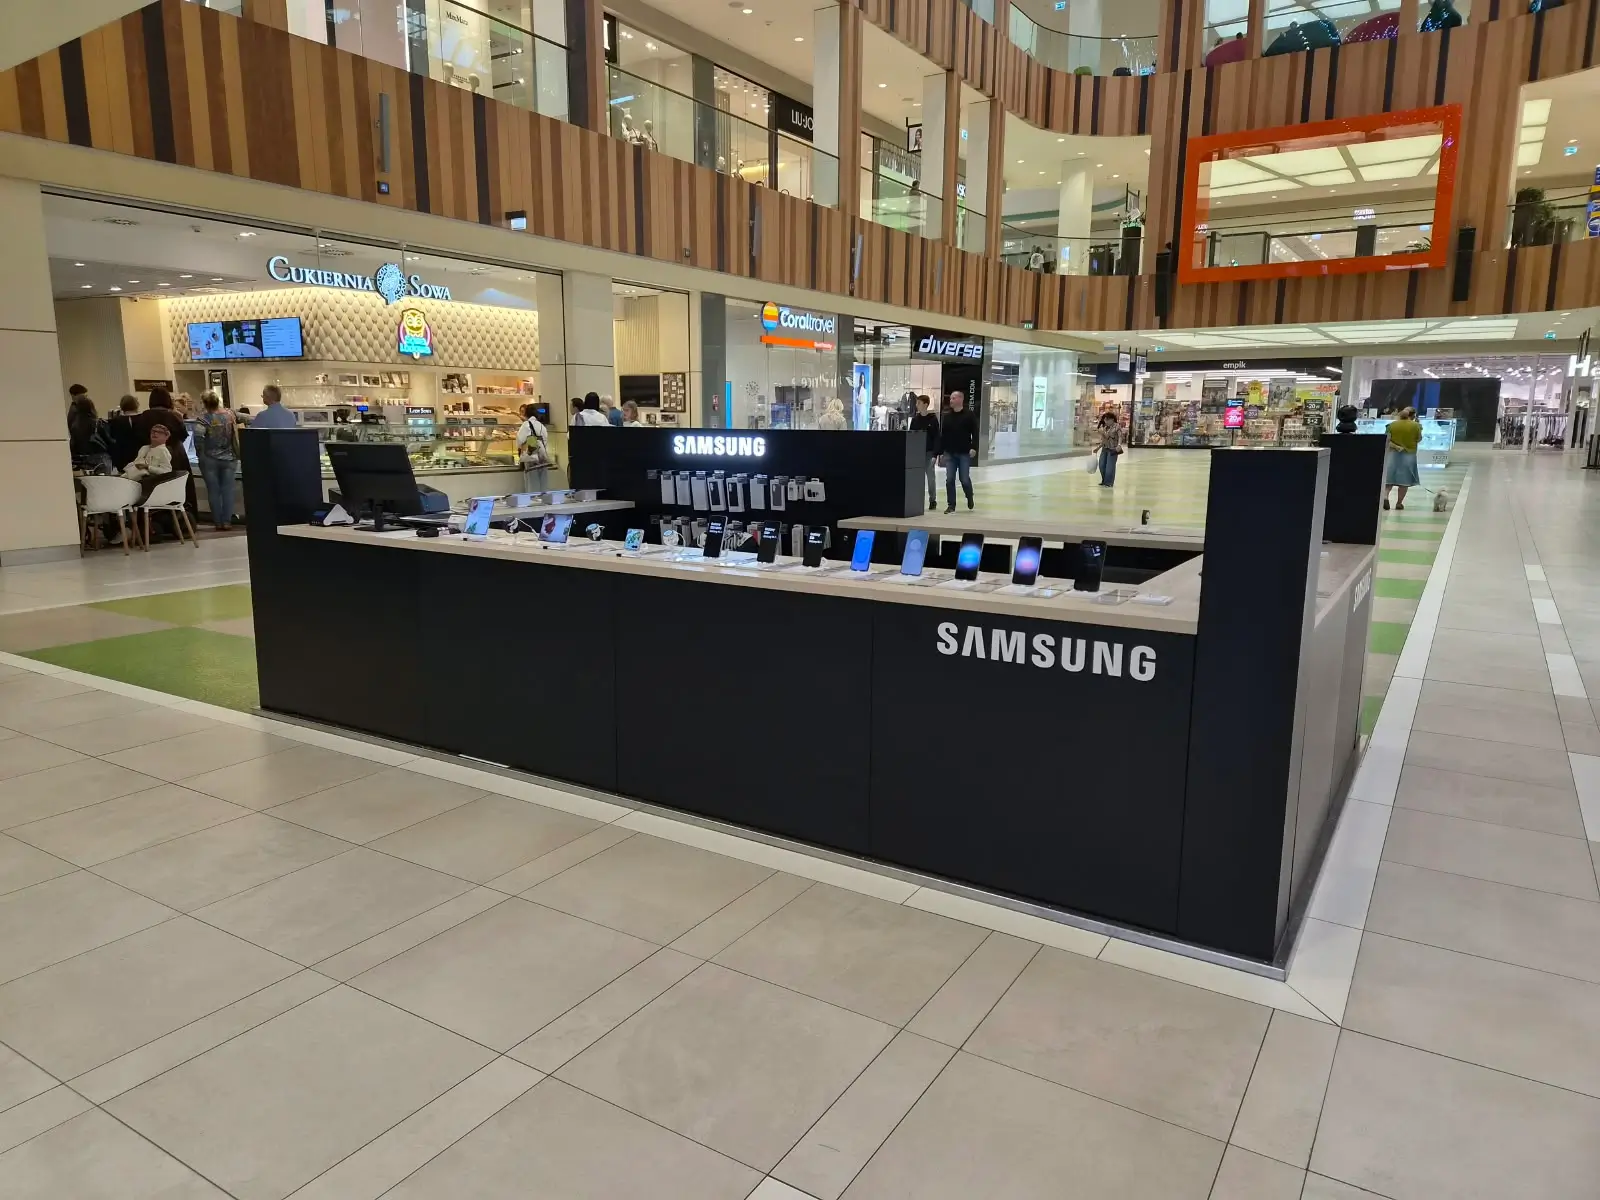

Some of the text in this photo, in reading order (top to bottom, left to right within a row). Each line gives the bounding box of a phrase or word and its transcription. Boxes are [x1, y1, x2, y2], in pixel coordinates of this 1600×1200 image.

[268, 255, 452, 300] CUKIERNIA SOWA
[918, 334, 984, 359] diverse
[1222, 360, 1247, 369] empik
[673, 435, 765, 457] SAMSUNG
[936, 621, 1157, 682] SAMSUNG
